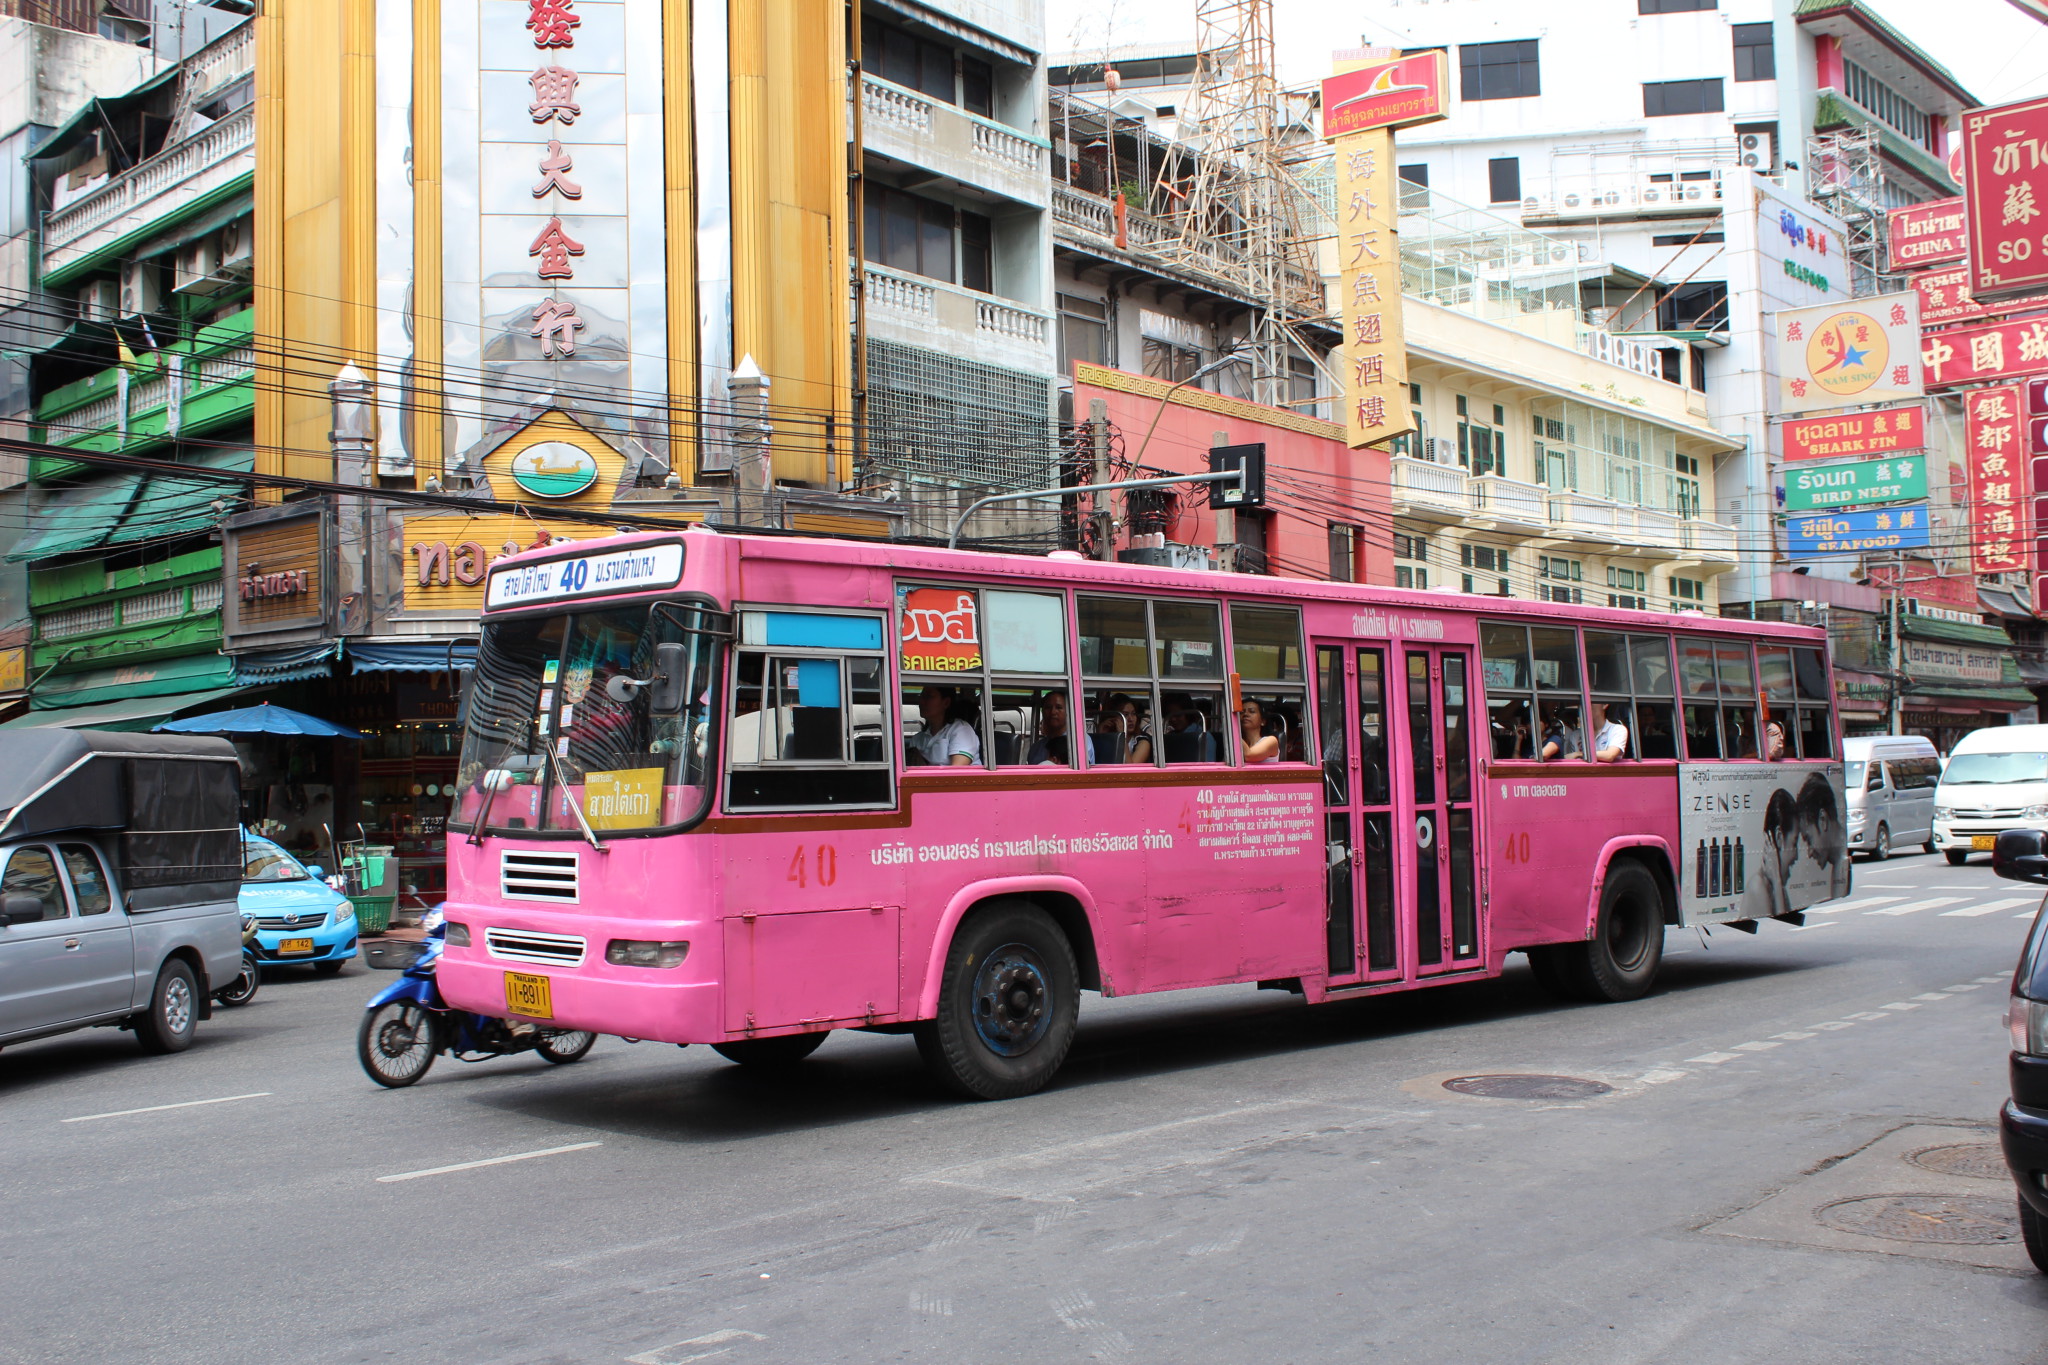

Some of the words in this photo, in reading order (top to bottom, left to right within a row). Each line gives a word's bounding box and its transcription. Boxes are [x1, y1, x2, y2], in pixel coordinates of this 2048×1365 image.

[1901, 238, 1953, 258] CHINA
[1998, 238, 2032, 264] SO
[1346, 148, 1387, 428] 海外天魚翅酒樓
[1823, 373, 1848, 386] NAM
[1851, 372, 1877, 383] SING
[1795, 420, 1863, 447] หูฉลาม
[1809, 439, 1865, 455] SHARK
[1869, 436, 1897, 449] FIN
[1797, 470, 1856, 490] รังนก
[1811, 489, 1853, 504] BIRD
[1857, 485, 1901, 499] NEST
[1817, 534, 1901, 551] SEAFOOD
[560, 559, 588, 592] 40
[1389, 614, 1400, 637] 40
[590, 781, 649, 817] สายใต้เก่า
[1197, 789, 1214, 804] 40
[1513, 785, 1529, 797] บาท
[1530, 784, 1567, 797] ตลอดสาย
[1693, 792, 1751, 813] ZENSE
[1247, 821, 1256, 831] 22
[871, 841, 915, 866] บริษัท
[984, 834, 1067, 859] ทรานสปอร์ต
[1142, 829, 1173, 850] จำกัด
[1505, 832, 1530, 865] 40
[787, 844, 836, 889] 40
[513, 974, 538, 984] THAILAND
[508, 981, 547, 1006] 11-8911
